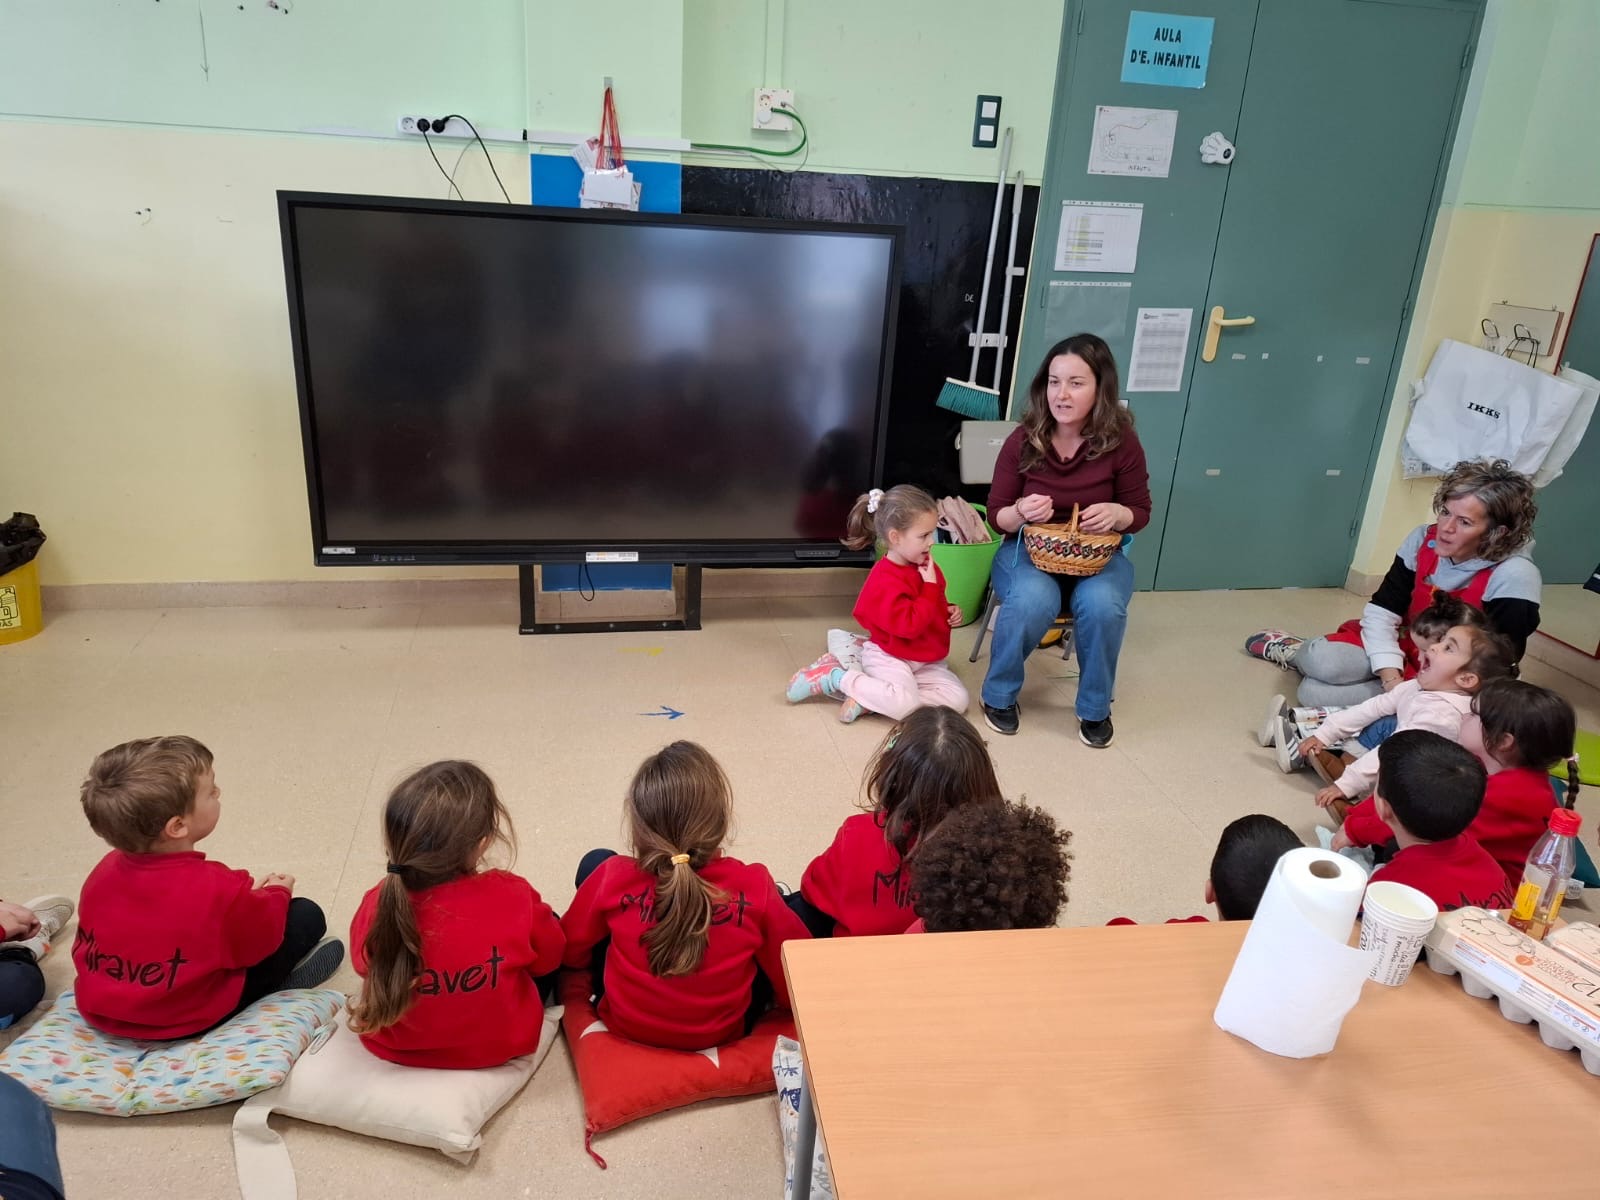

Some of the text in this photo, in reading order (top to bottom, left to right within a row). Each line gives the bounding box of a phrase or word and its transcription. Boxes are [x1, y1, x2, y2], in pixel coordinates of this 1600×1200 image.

[1154, 28, 1182, 43] AULA
[1130, 50, 1201, 69] D'E. INFANTIL
[1467, 401, 1501, 420] IKKS
[72, 926, 190, 990] Miravet
